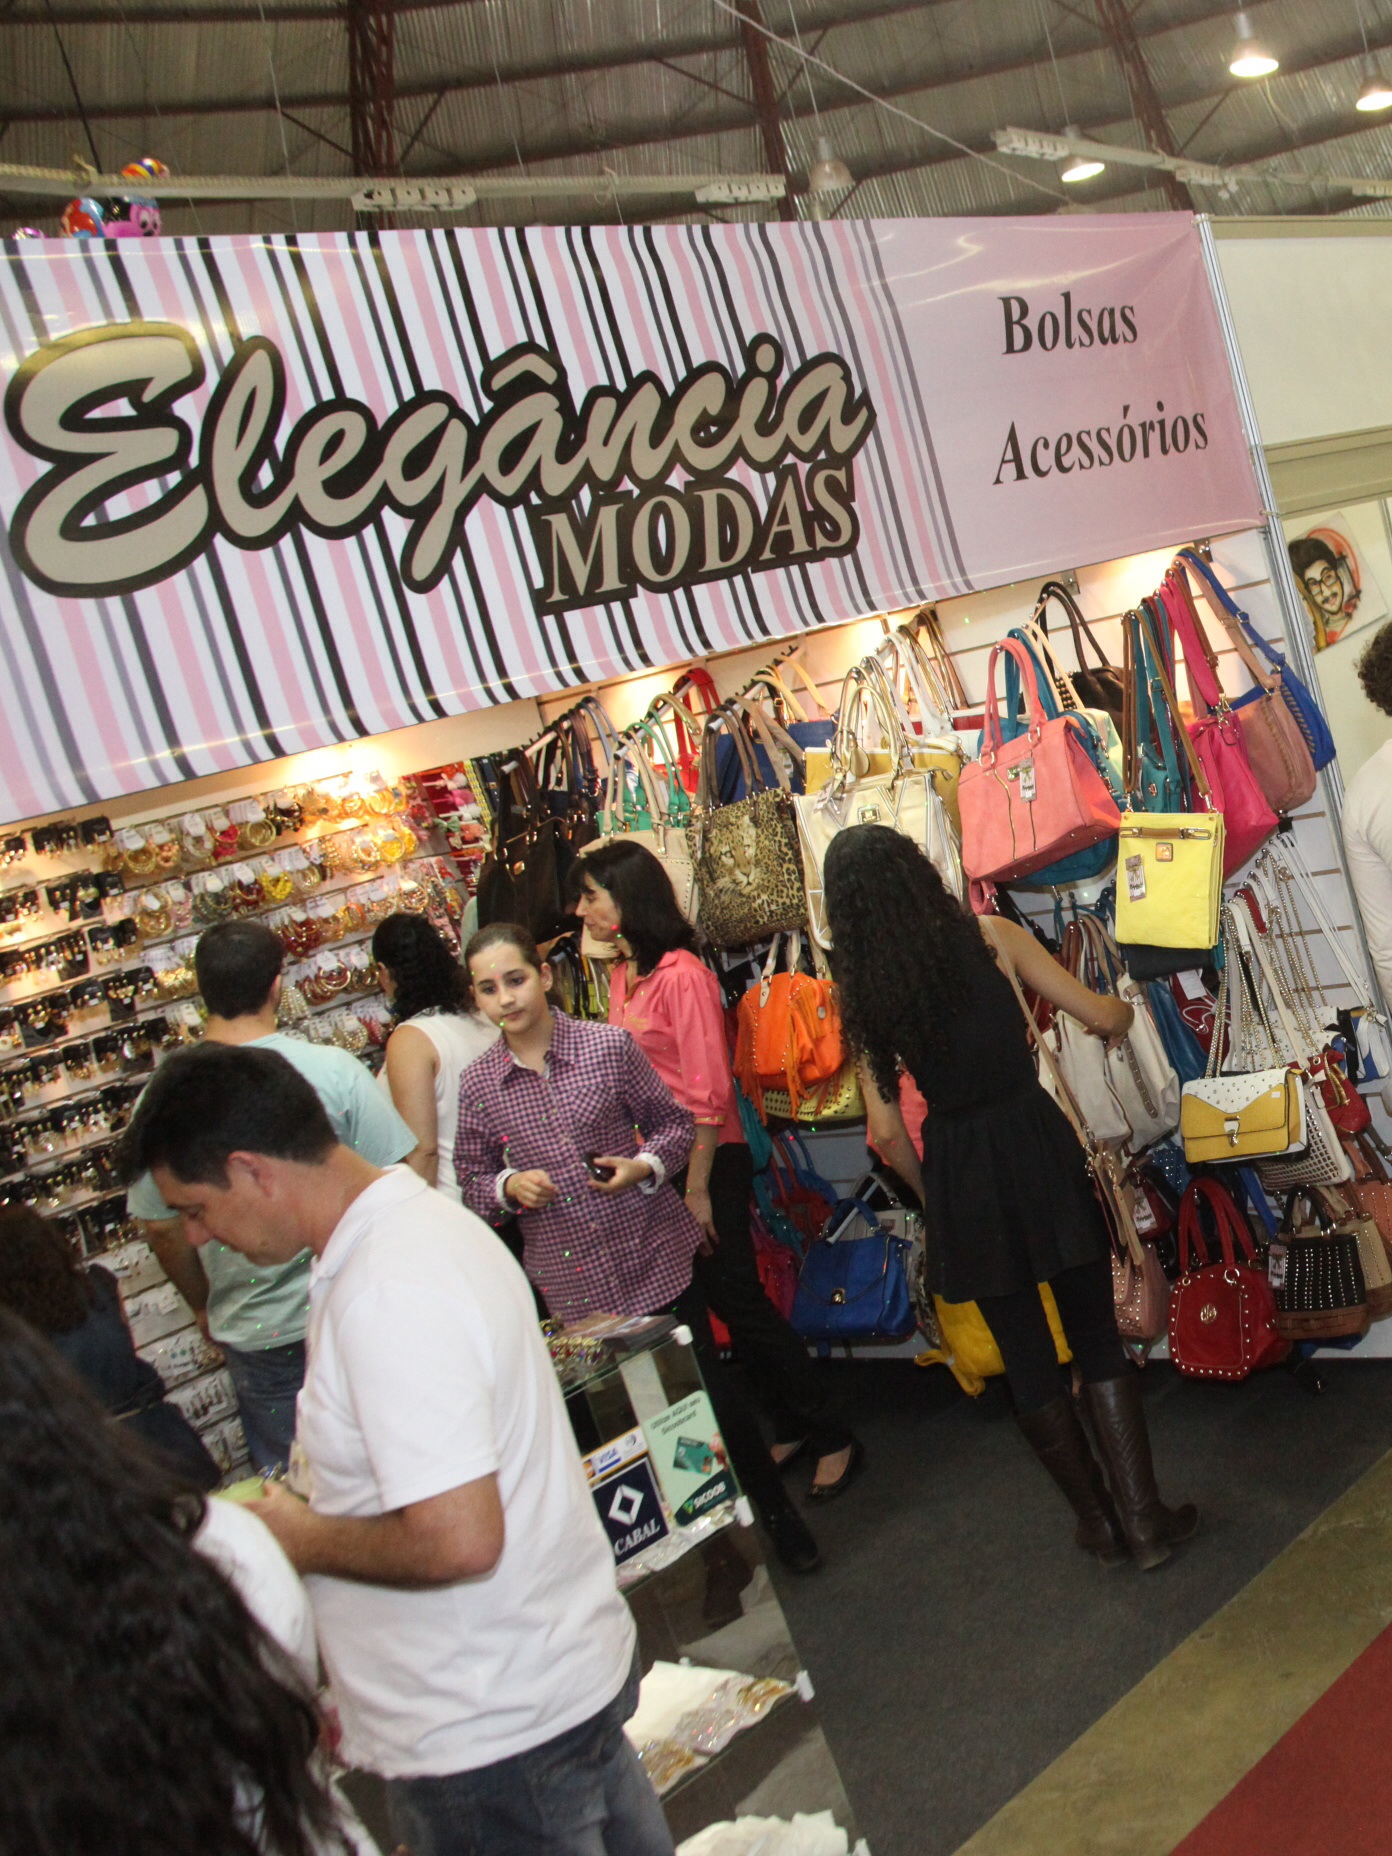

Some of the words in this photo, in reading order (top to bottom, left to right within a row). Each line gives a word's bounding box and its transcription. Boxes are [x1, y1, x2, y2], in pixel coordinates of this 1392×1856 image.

[997, 290, 1138, 355] Bolsas
[5, 321, 876, 598] Elegância
[991, 400, 1209, 486] Acessórios
[538, 462, 860, 614] MODAS
[599, 1448, 618, 1465] VISA
[613, 1518, 661, 1557] CABAL
